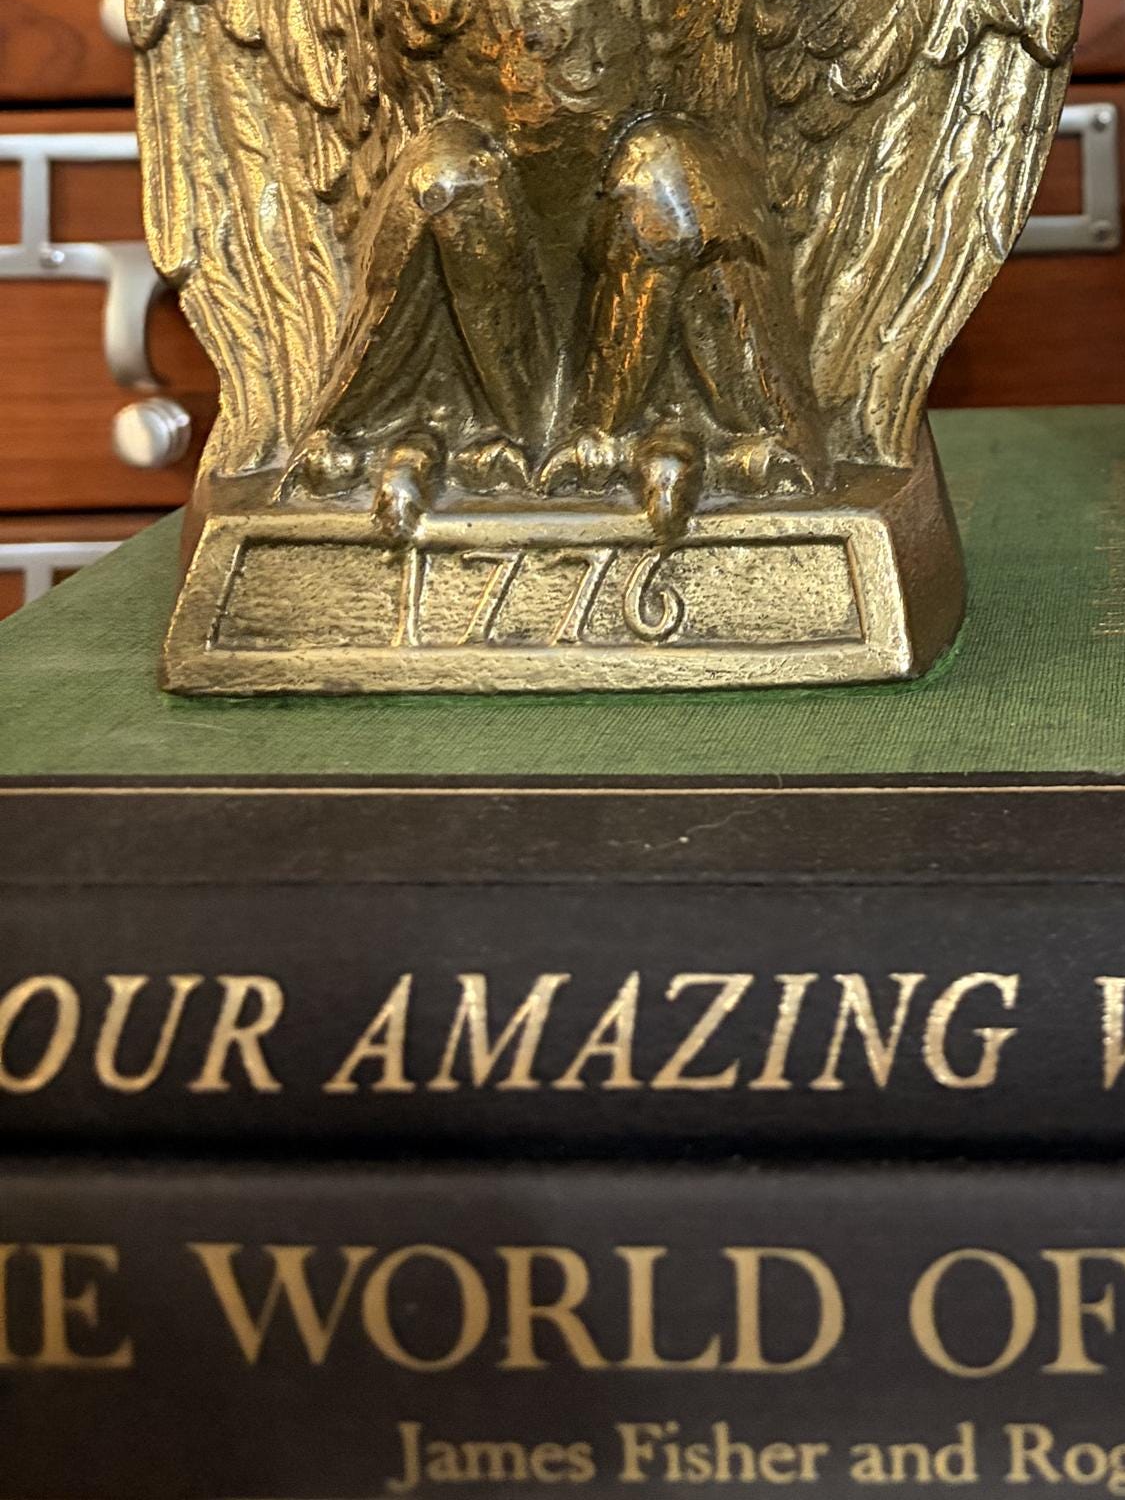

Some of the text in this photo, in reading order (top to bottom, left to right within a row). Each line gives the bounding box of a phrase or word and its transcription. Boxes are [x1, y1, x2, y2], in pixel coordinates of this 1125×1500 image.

[384, 544, 687, 648] 1776
[0, 973, 285, 1092] OUR
[323, 970, 1021, 1092] AMAZING
[186, 1242, 847, 1374] WORLD
[388, 1419, 597, 1490] James
[614, 1418, 830, 1487] Fisher
[849, 1420, 981, 1488] and
